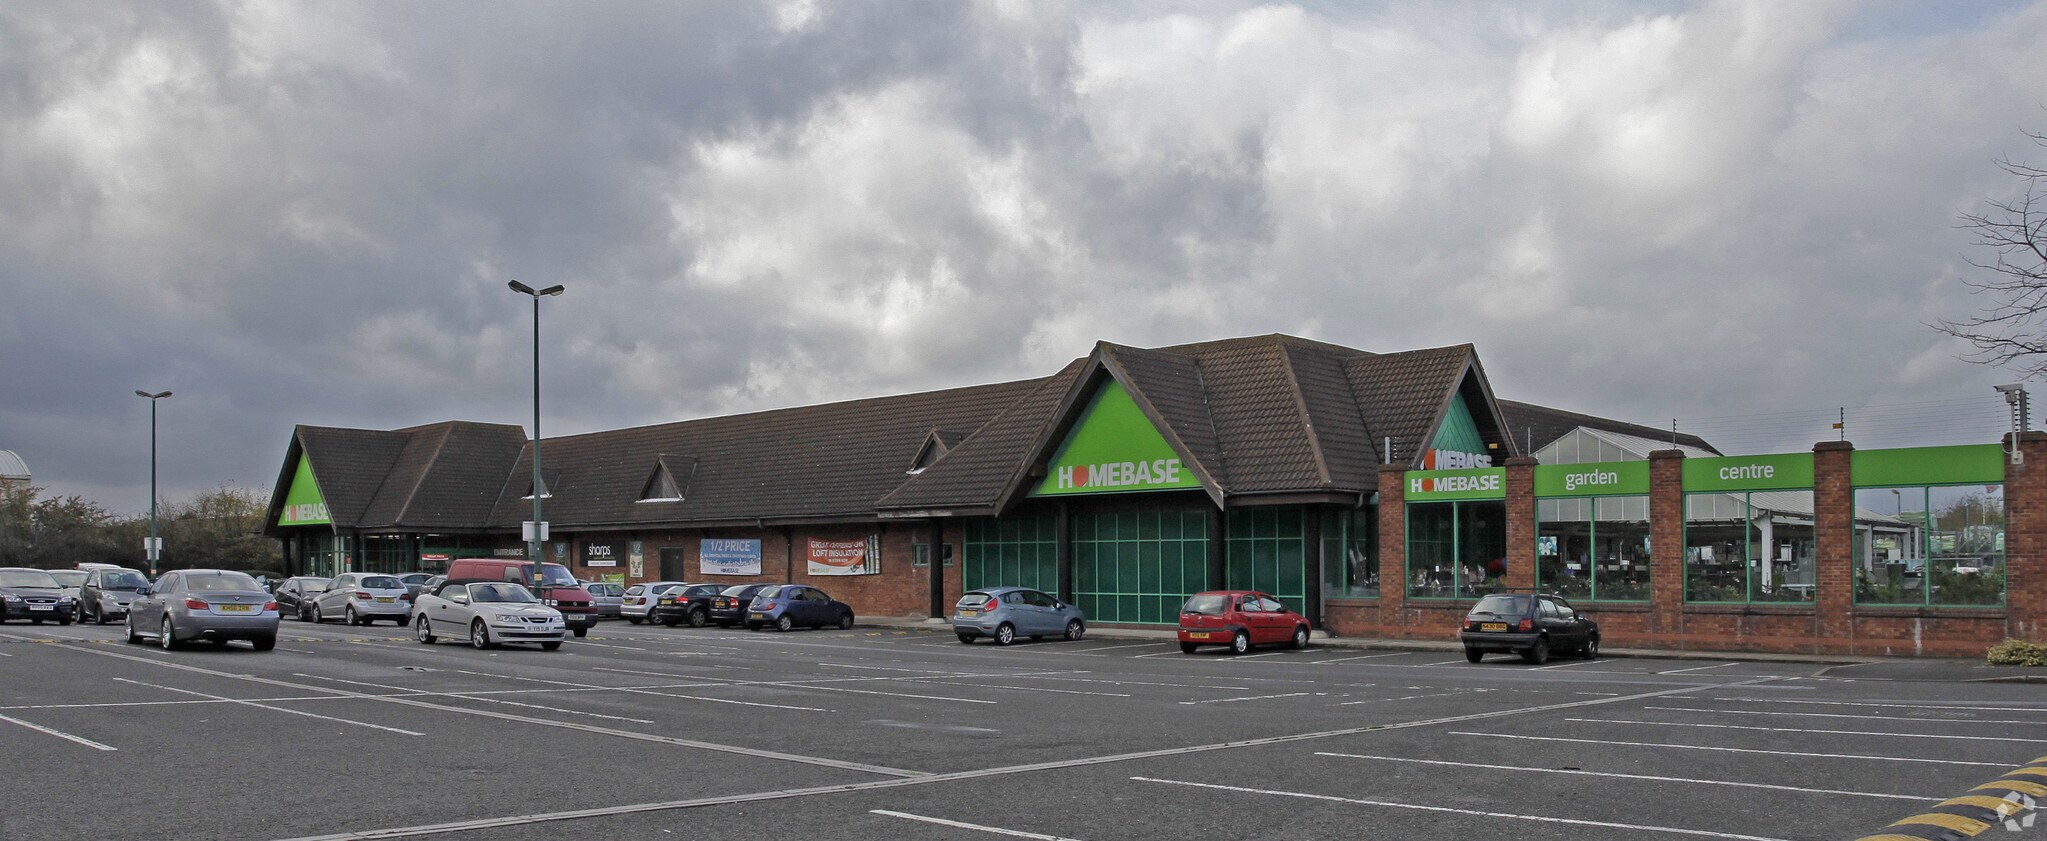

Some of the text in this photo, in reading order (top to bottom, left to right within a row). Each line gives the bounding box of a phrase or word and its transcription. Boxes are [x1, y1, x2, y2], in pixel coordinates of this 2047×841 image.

[1420, 448, 1492, 471] OMEBASE
[1058, 458, 1180, 489] HOMEBASE
[1565, 468, 1618, 491] garden
[1719, 463, 1775, 480] centre
[1411, 475, 1500, 493] HOMEBASE
[588, 542, 611, 559] sharps
[710, 540, 751, 552] 1/2 PRICE
[812, 548, 863, 557] LOFT INSULATION
